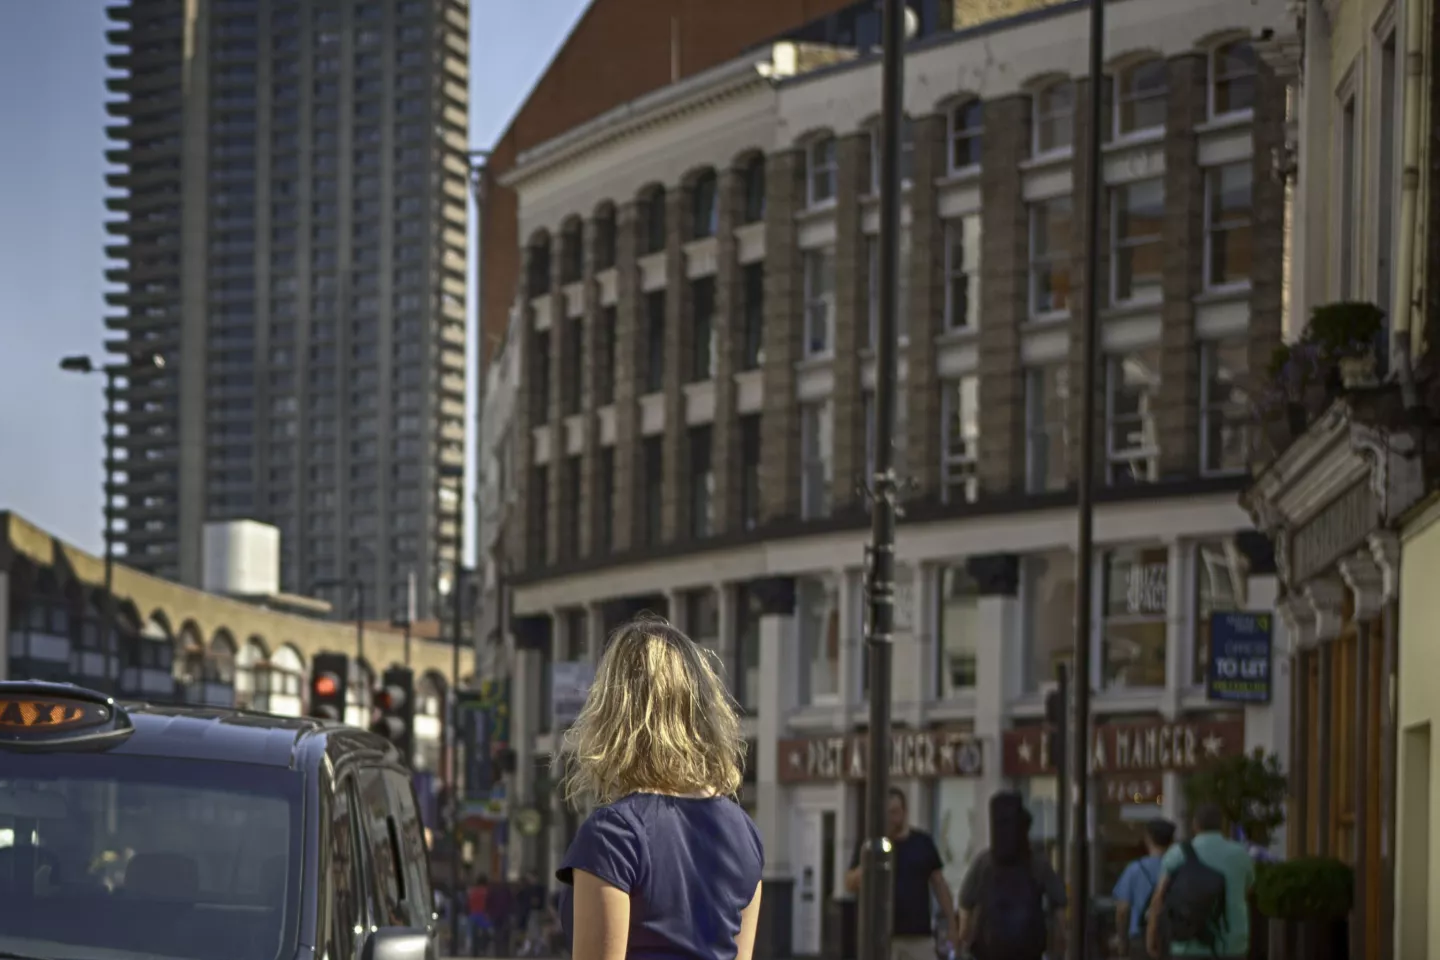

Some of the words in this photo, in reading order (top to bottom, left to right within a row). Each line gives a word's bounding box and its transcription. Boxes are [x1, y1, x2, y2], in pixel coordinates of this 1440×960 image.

[1215, 658, 1238, 679] TO
[1240, 658, 1268, 679] LET
[808, 737, 845, 779] PRET
[1116, 723, 1197, 769] MANGER
